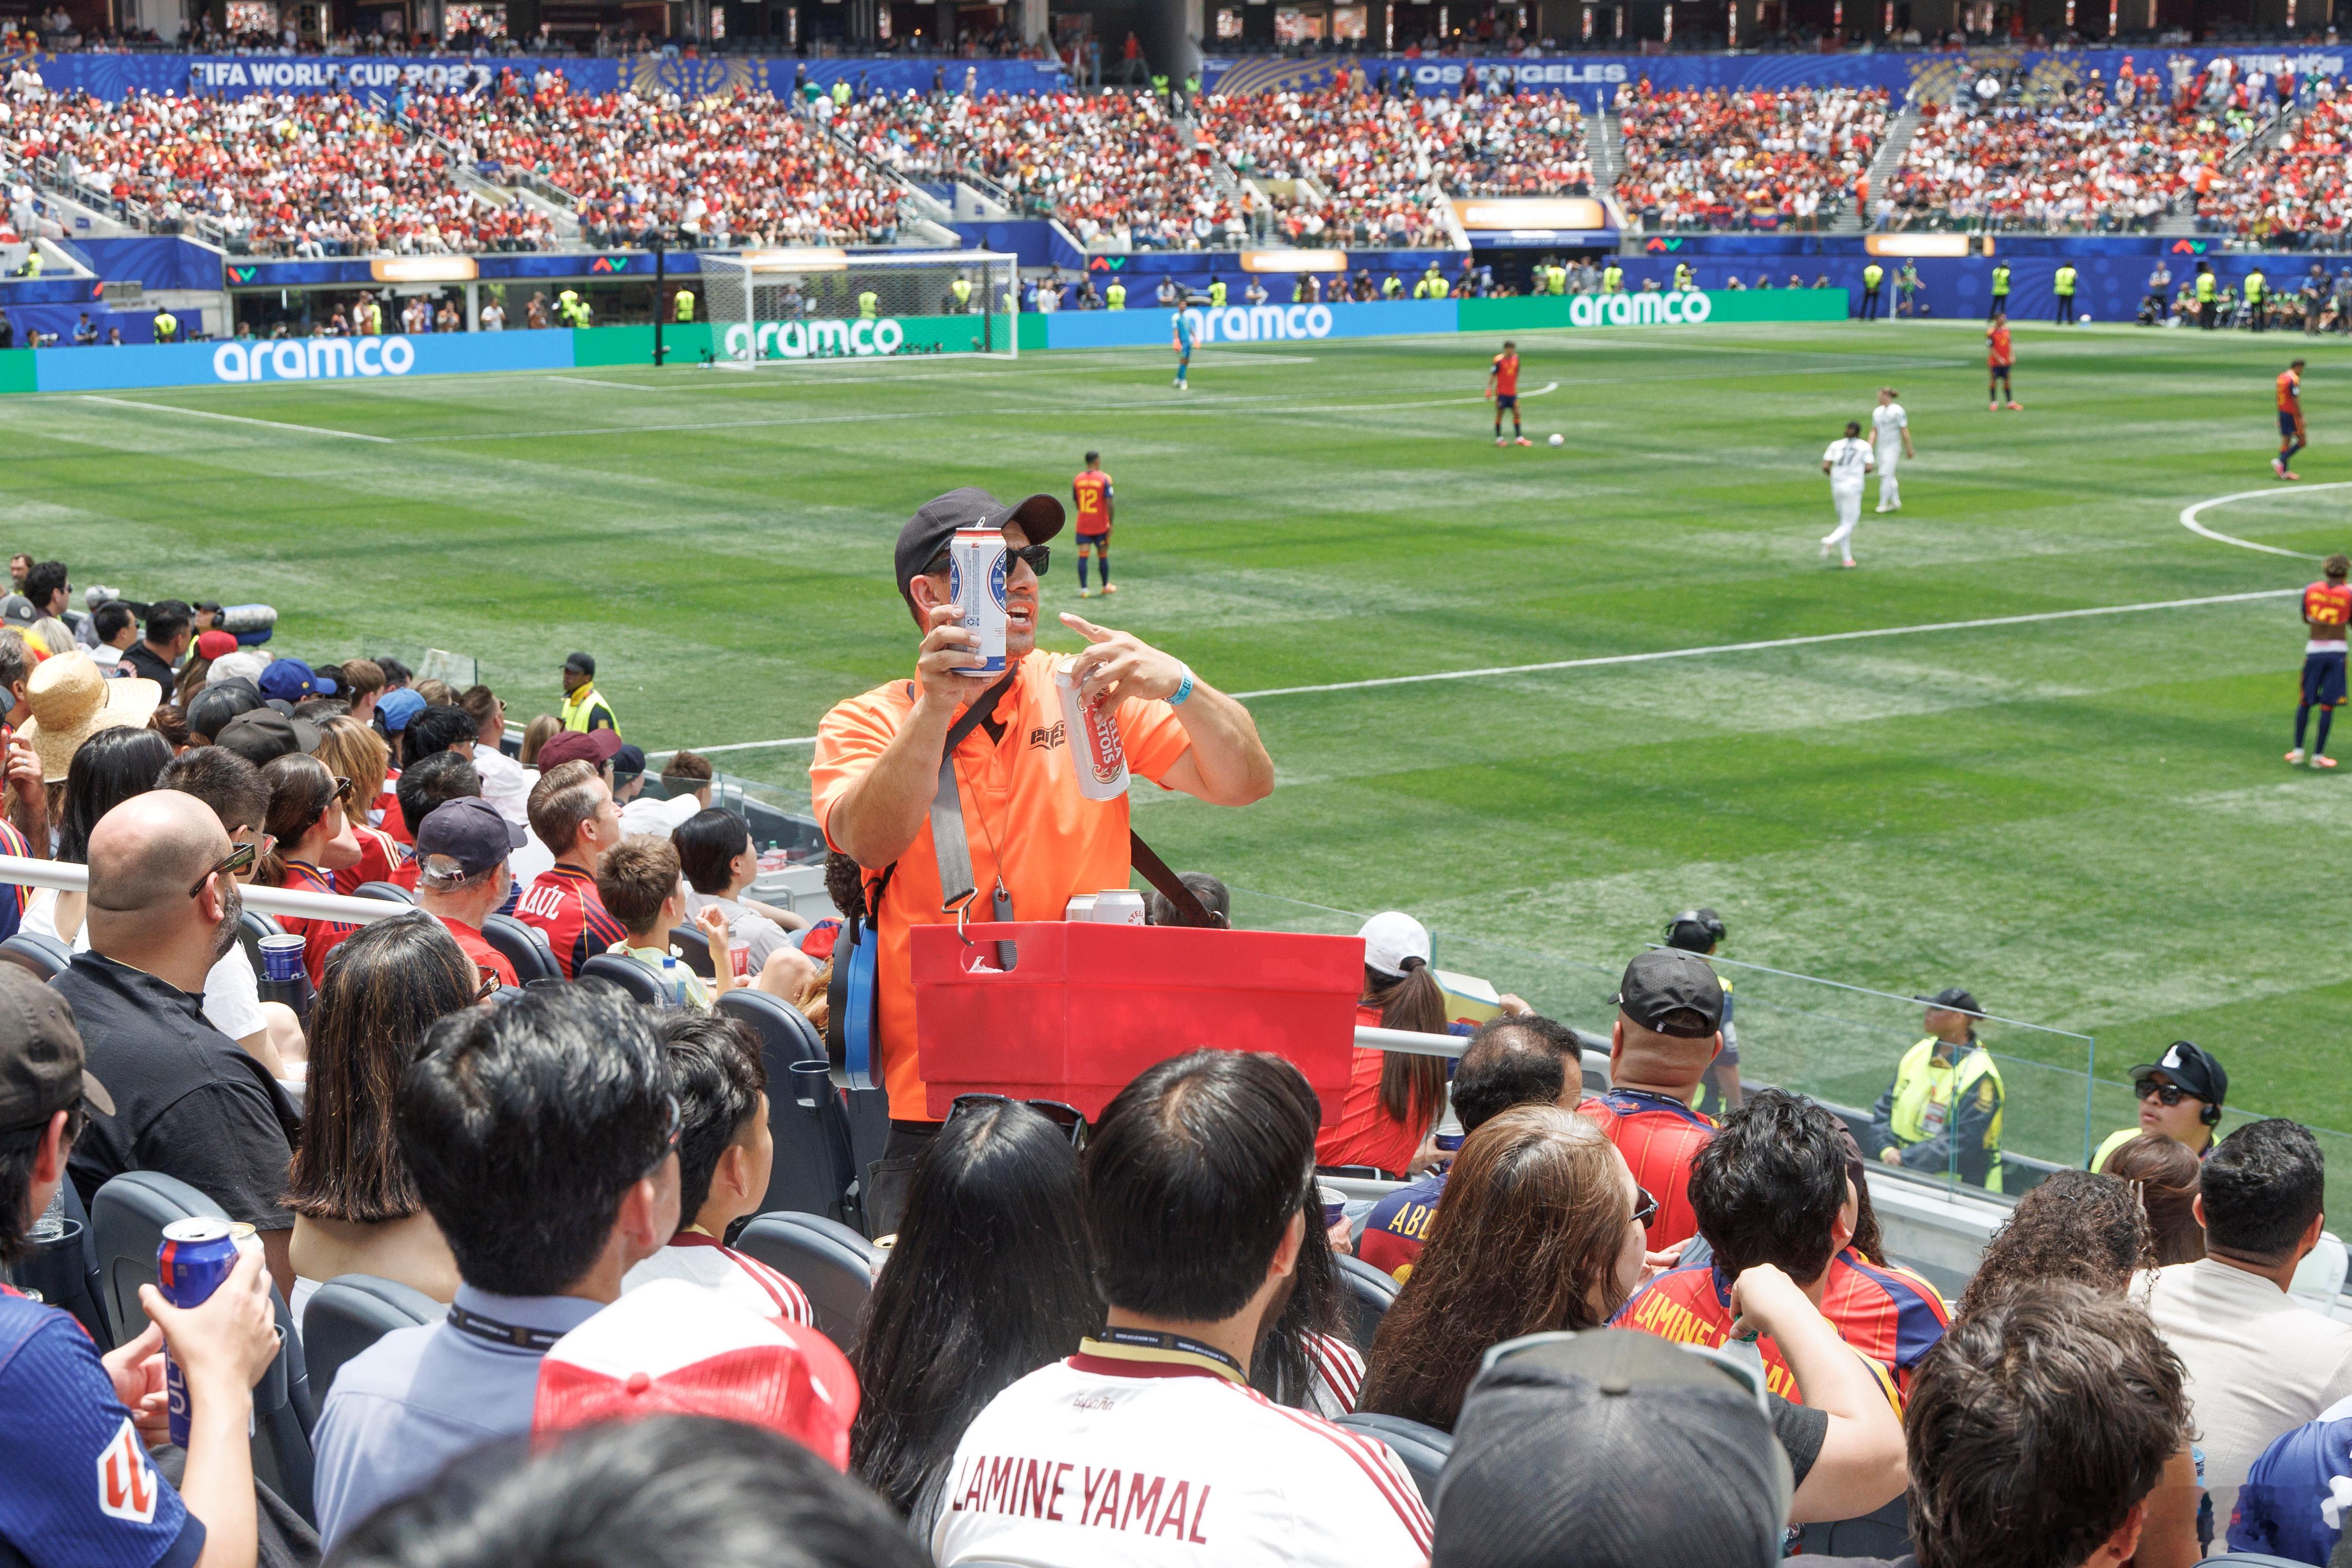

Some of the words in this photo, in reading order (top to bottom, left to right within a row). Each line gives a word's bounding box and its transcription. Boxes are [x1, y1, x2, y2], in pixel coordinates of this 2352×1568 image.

[349, 64, 400, 87] CUP
[1569, 292, 1712, 327] aramco
[724, 318, 904, 358] aramco
[213, 336, 415, 381] aramco
[1080, 488, 1098, 513] 12
[1634, 1288, 1715, 1346] LAMINE
[953, 1456, 1075, 1522] LAMINE
[1080, 1466, 1211, 1545] YAMAL
